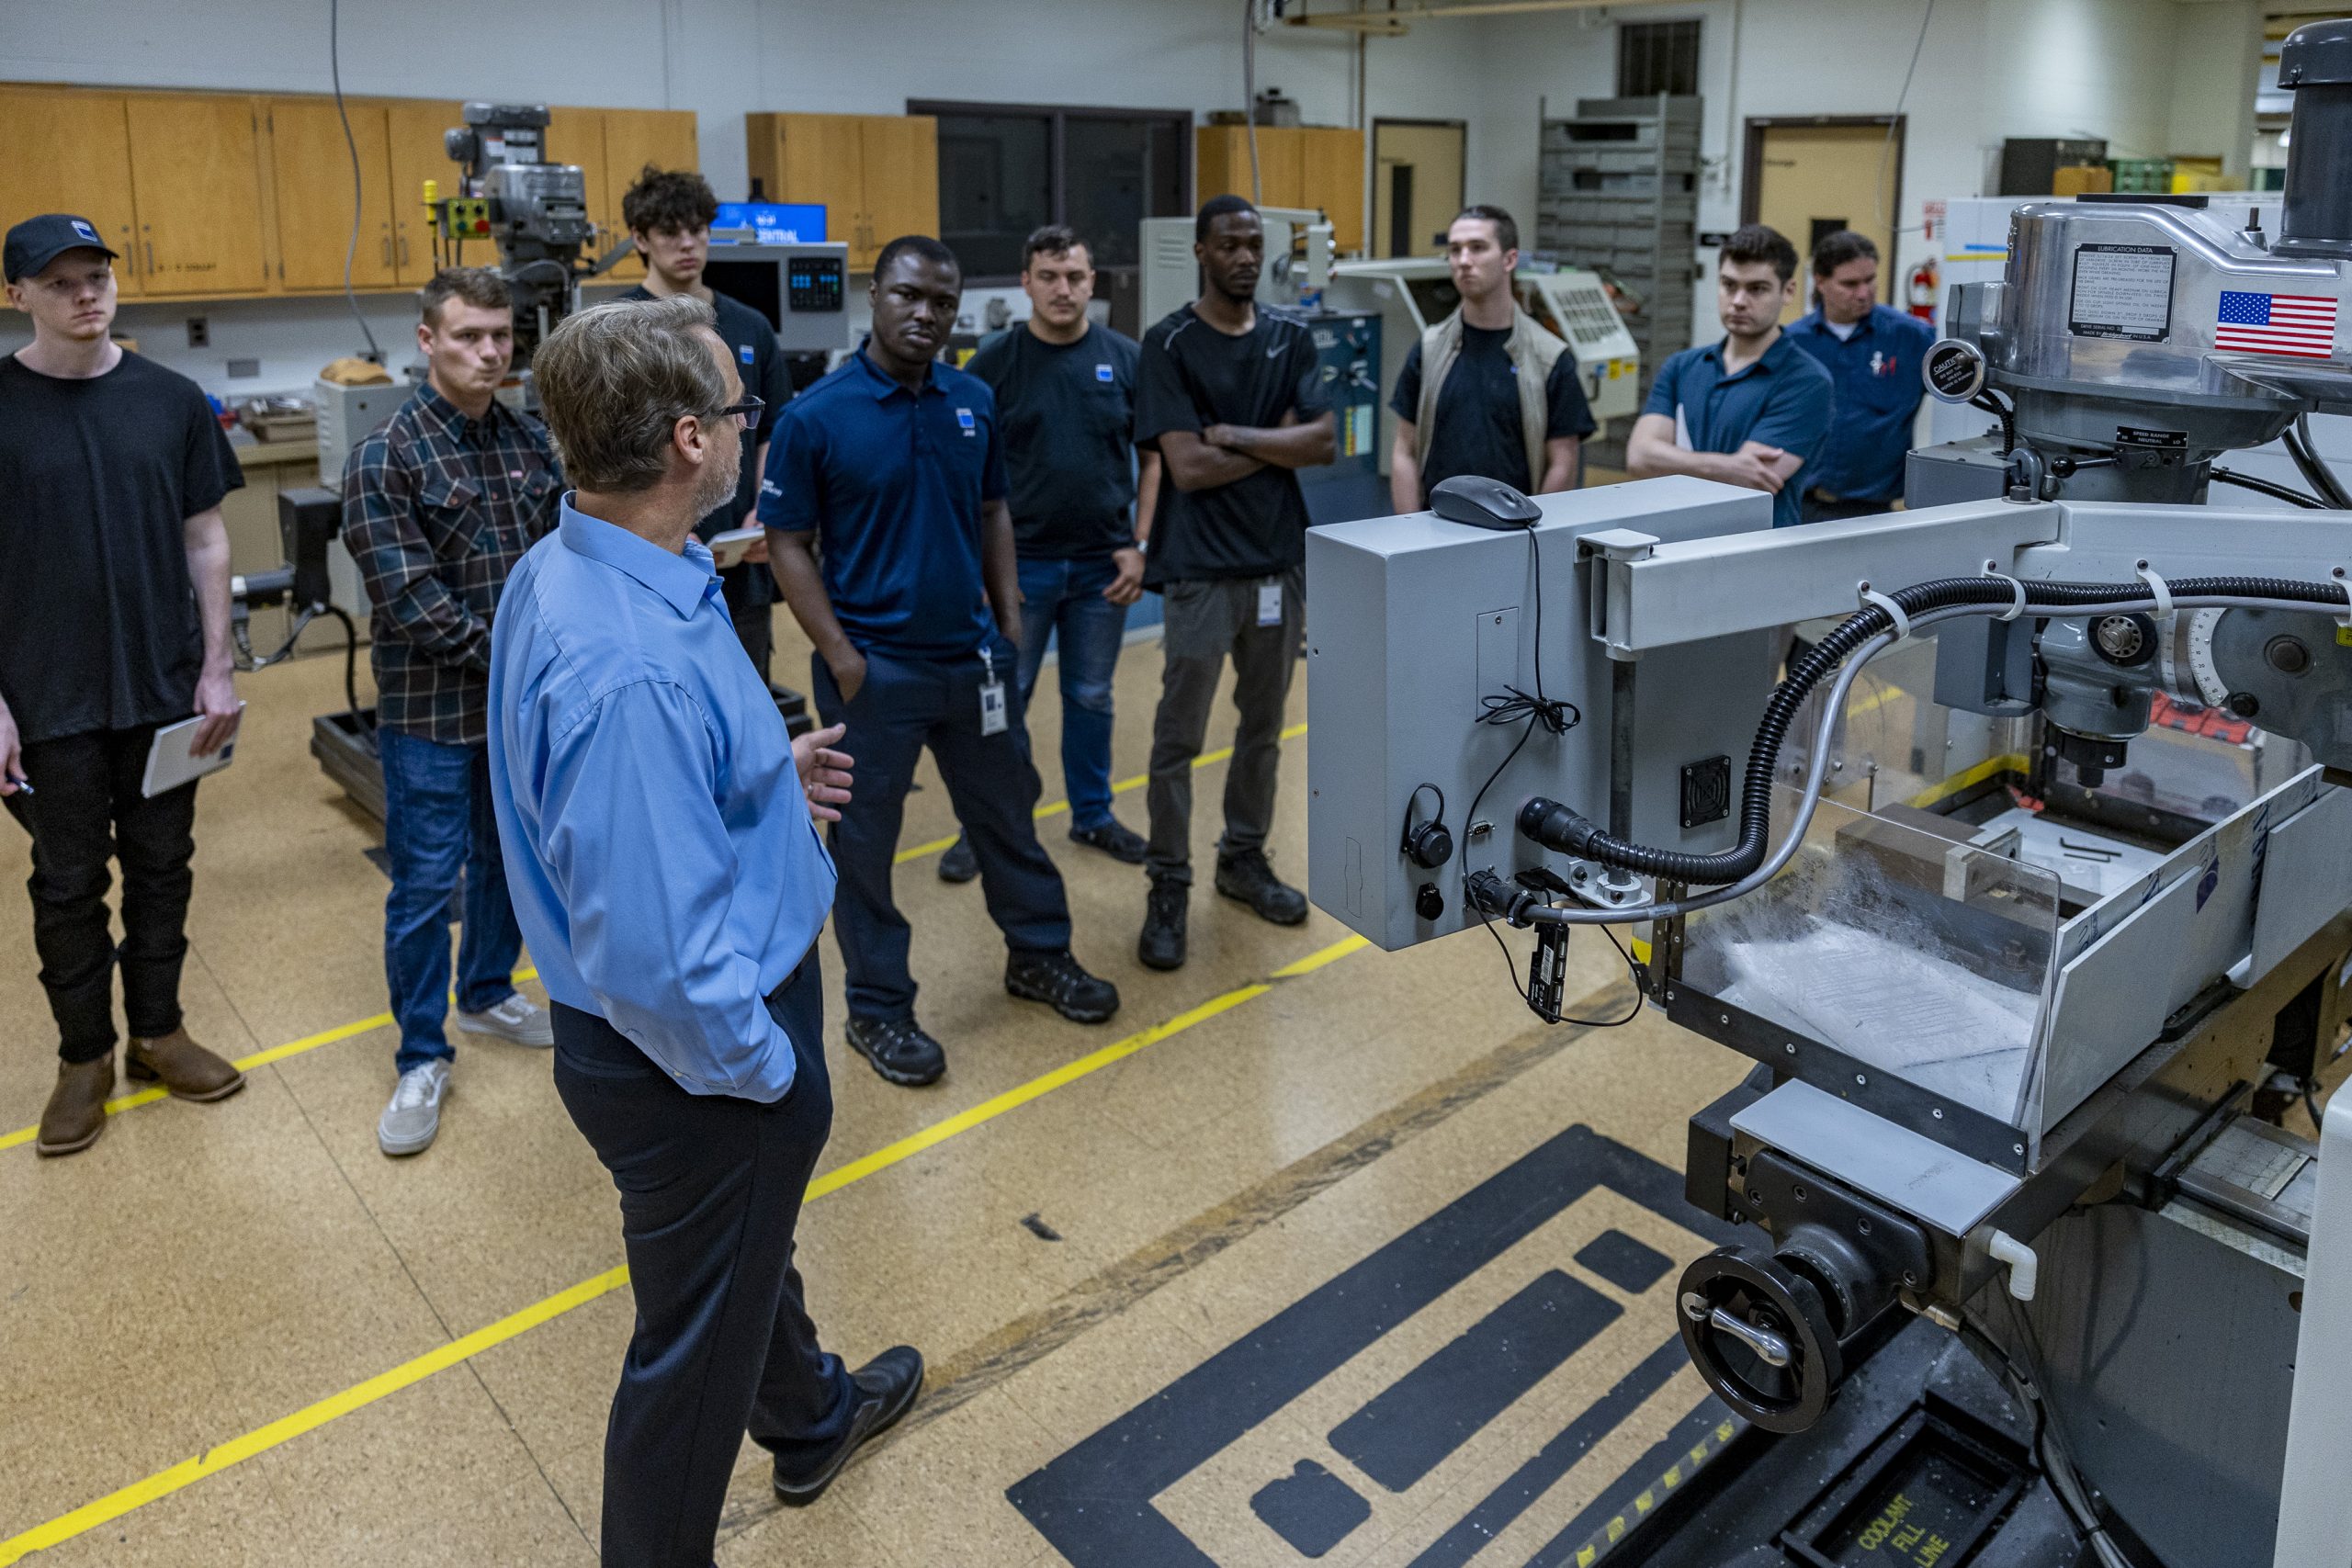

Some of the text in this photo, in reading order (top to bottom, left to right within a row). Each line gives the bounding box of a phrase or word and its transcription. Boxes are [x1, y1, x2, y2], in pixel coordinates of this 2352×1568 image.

[1858, 1493, 1913, 1551] COOLANT
[1890, 1524, 1926, 1553] FILL
[1913, 1534, 1951, 1568] LINE
